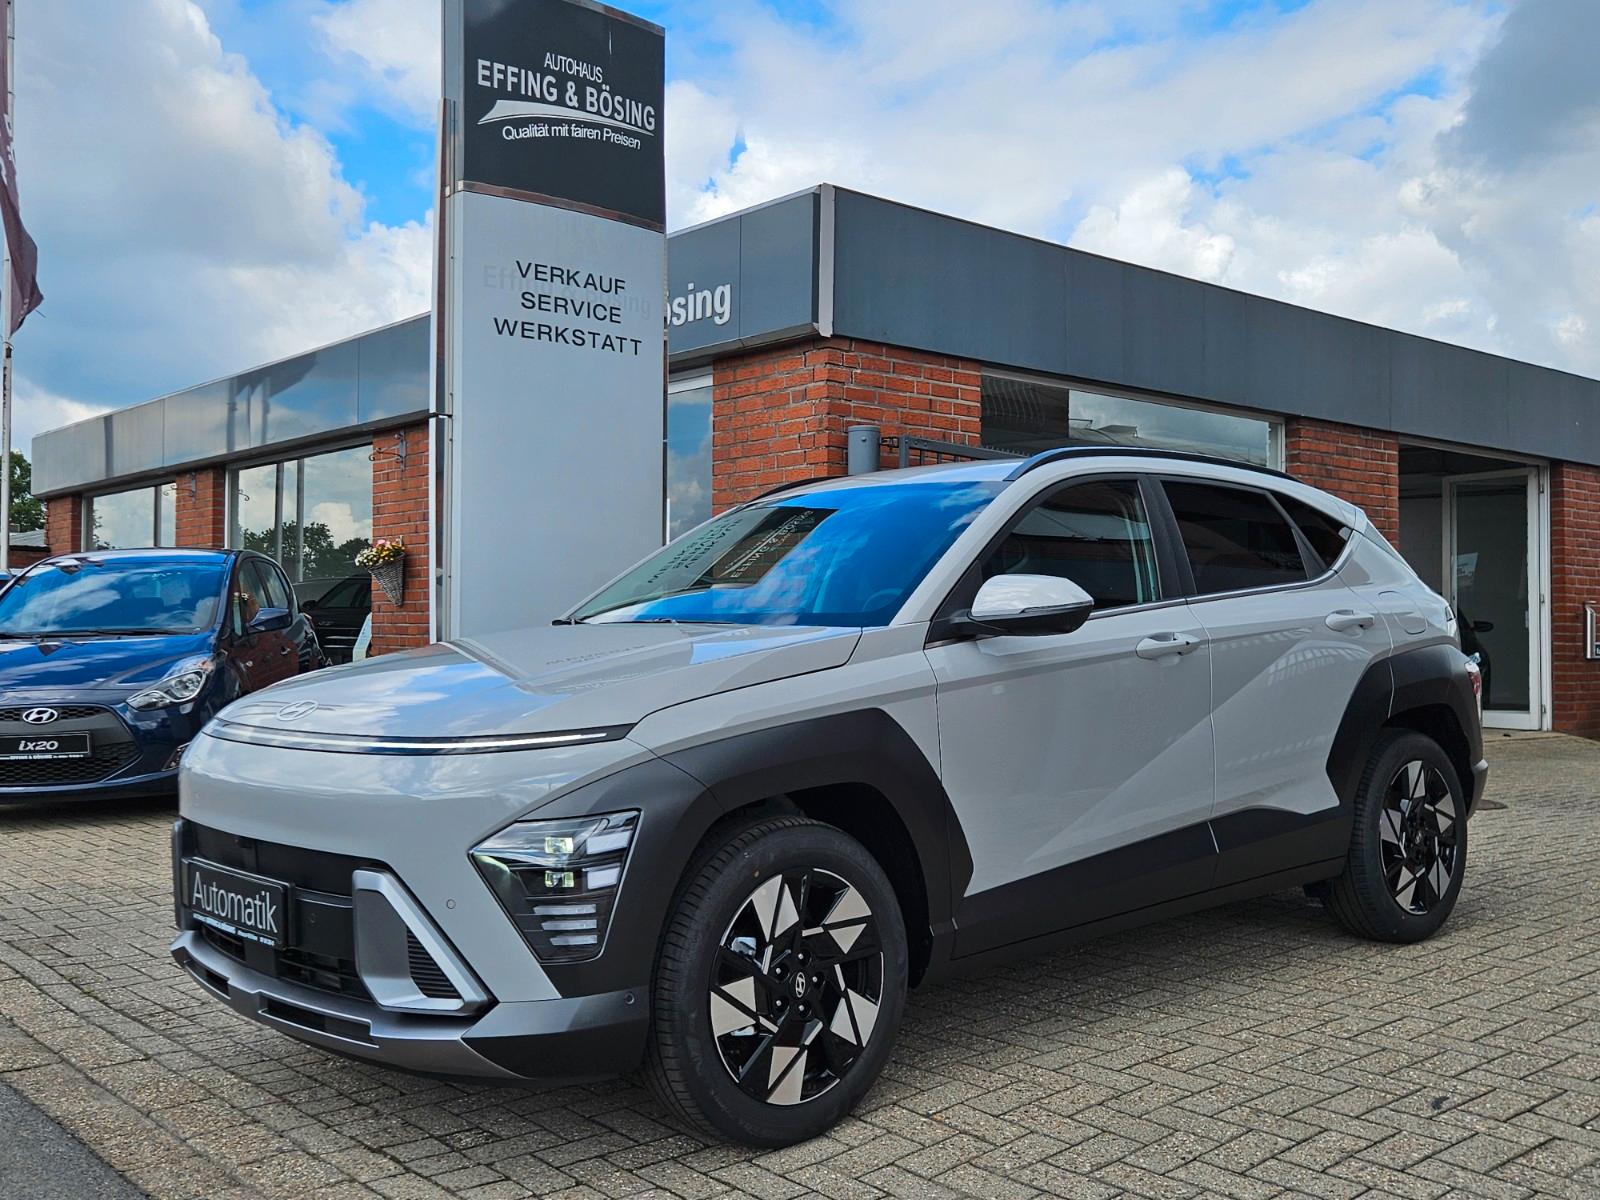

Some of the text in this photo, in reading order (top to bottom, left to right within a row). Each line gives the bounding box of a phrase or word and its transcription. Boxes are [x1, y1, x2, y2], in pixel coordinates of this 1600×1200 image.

[544, 52, 603, 83] AUTOHAUS
[477, 59, 655, 131] EFFING & BÖSING
[502, 123, 641, 150] Qualität mit fairen Preisen
[516, 260, 626, 295] VERKAUF
[521, 292, 623, 324] SERVICE
[667, 282, 731, 326] sing
[494, 318, 642, 356] WERKSTATT
[18, 740, 58, 751] ix20
[192, 871, 278, 933] Automatik
